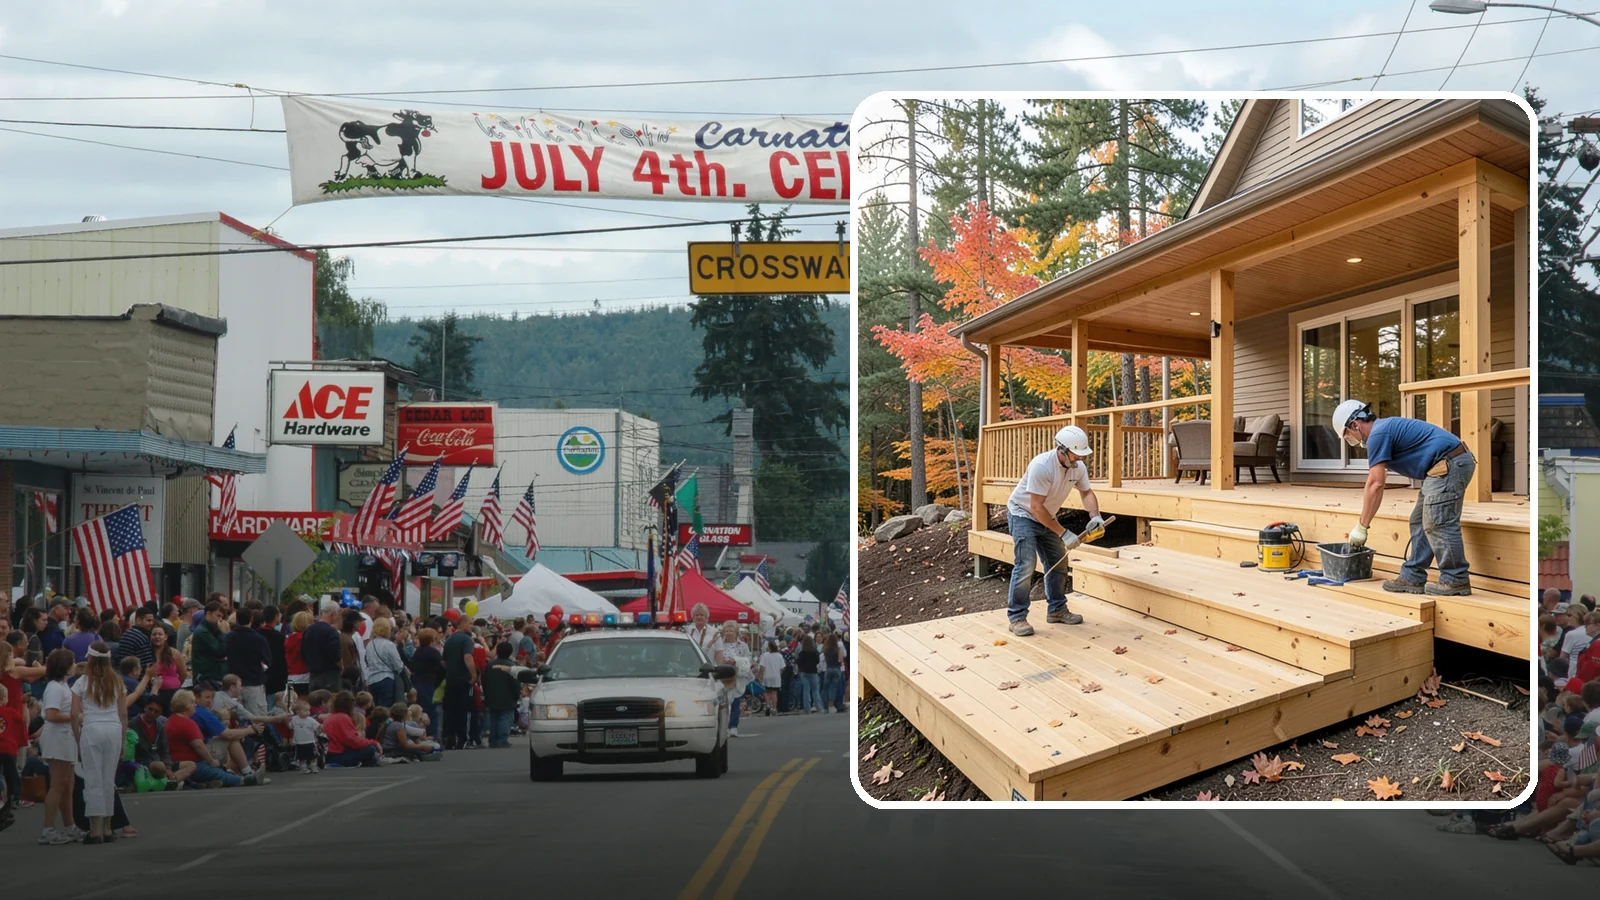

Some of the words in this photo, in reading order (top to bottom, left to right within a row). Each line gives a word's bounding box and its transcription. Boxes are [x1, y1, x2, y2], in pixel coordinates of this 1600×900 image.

[481, 141, 605, 193] JULY
[632, 150, 746, 198] 4th.
[697, 254, 850, 280] CROSSWA
[283, 380, 373, 420] ACE
[405, 409, 453, 422] CEDAR
[283, 421, 371, 437] Hardware
[416, 428, 477, 447] Coca-Cola
[95, 485, 124, 495] Vincent
[126, 486, 136, 495] de
[138, 486, 155, 495] Paul
[688, 526, 742, 535] CRNATION
[699, 535, 731, 544] GLASS
